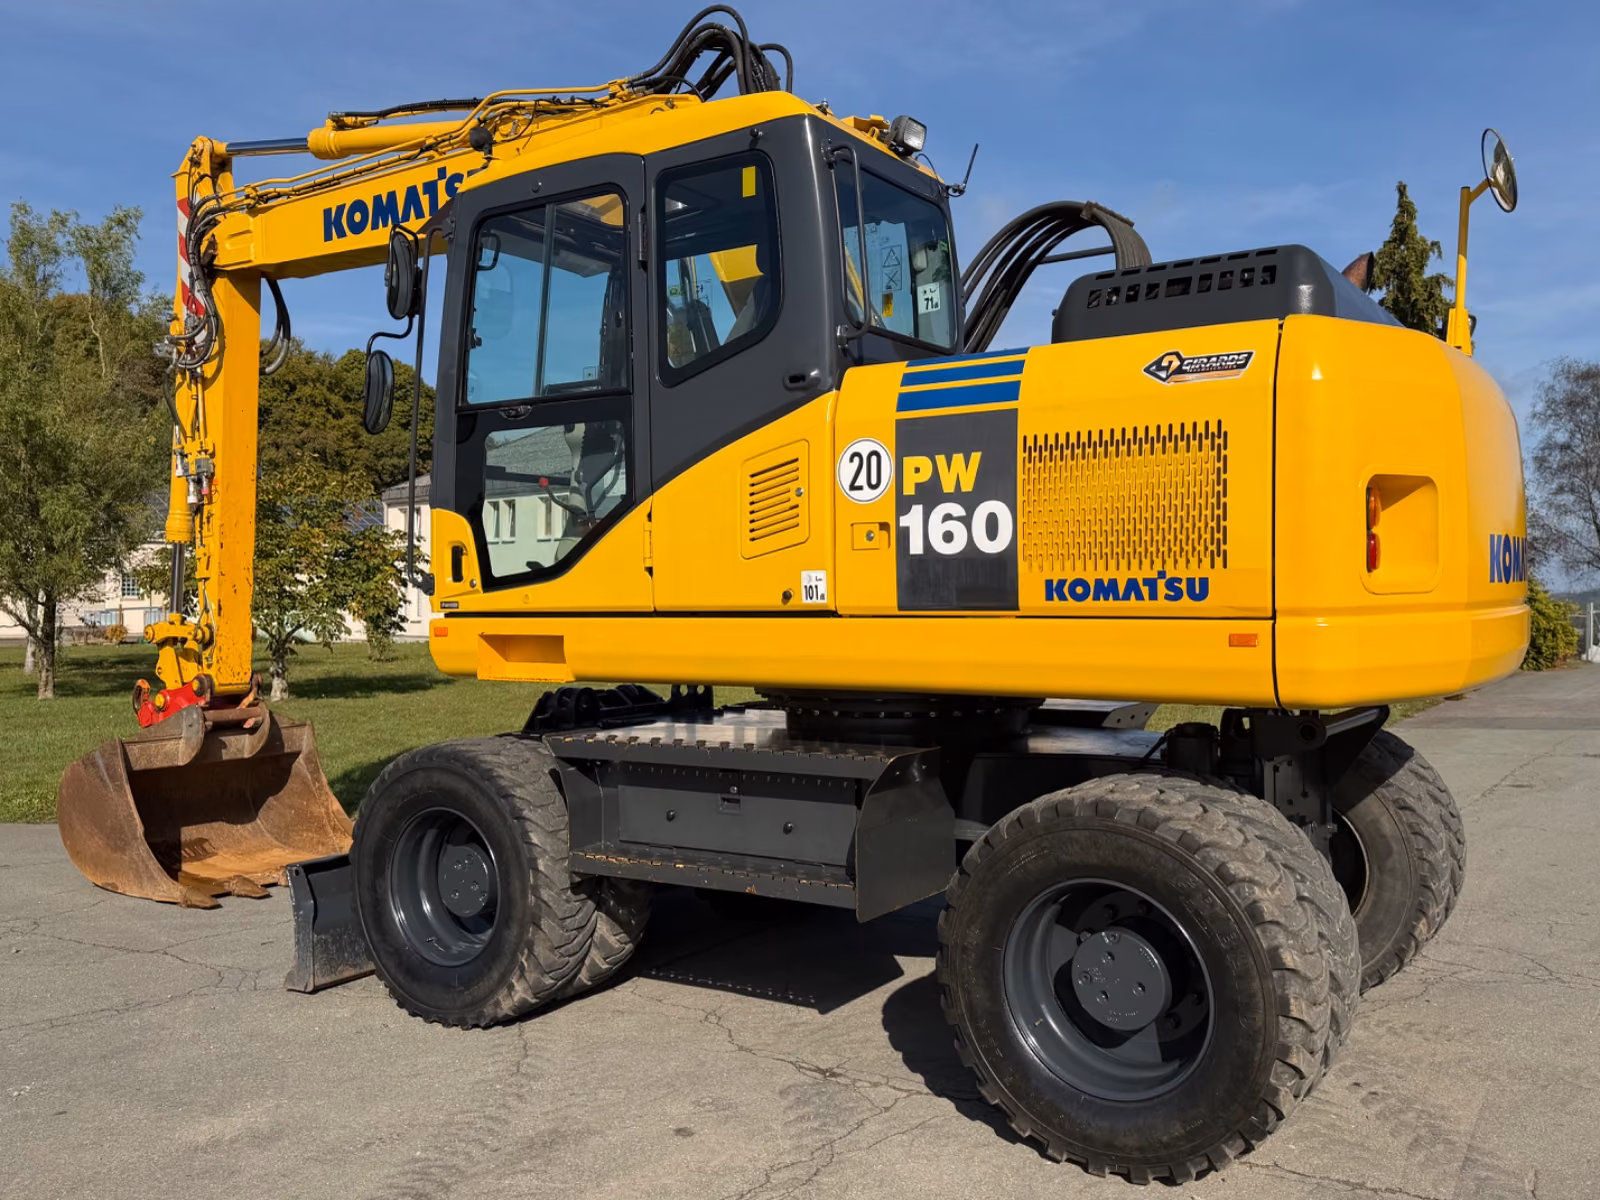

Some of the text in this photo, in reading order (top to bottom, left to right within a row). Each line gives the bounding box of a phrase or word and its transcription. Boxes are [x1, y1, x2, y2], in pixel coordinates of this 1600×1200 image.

[323, 166, 482, 242] KOMATS
[1182, 353, 1248, 371] GIRARDS
[849, 450, 882, 491] 20
[903, 451, 982, 495] PW
[900, 500, 1013, 555] 160
[804, 584, 819, 601] 101
[1045, 570, 1209, 602] KOMATSU
